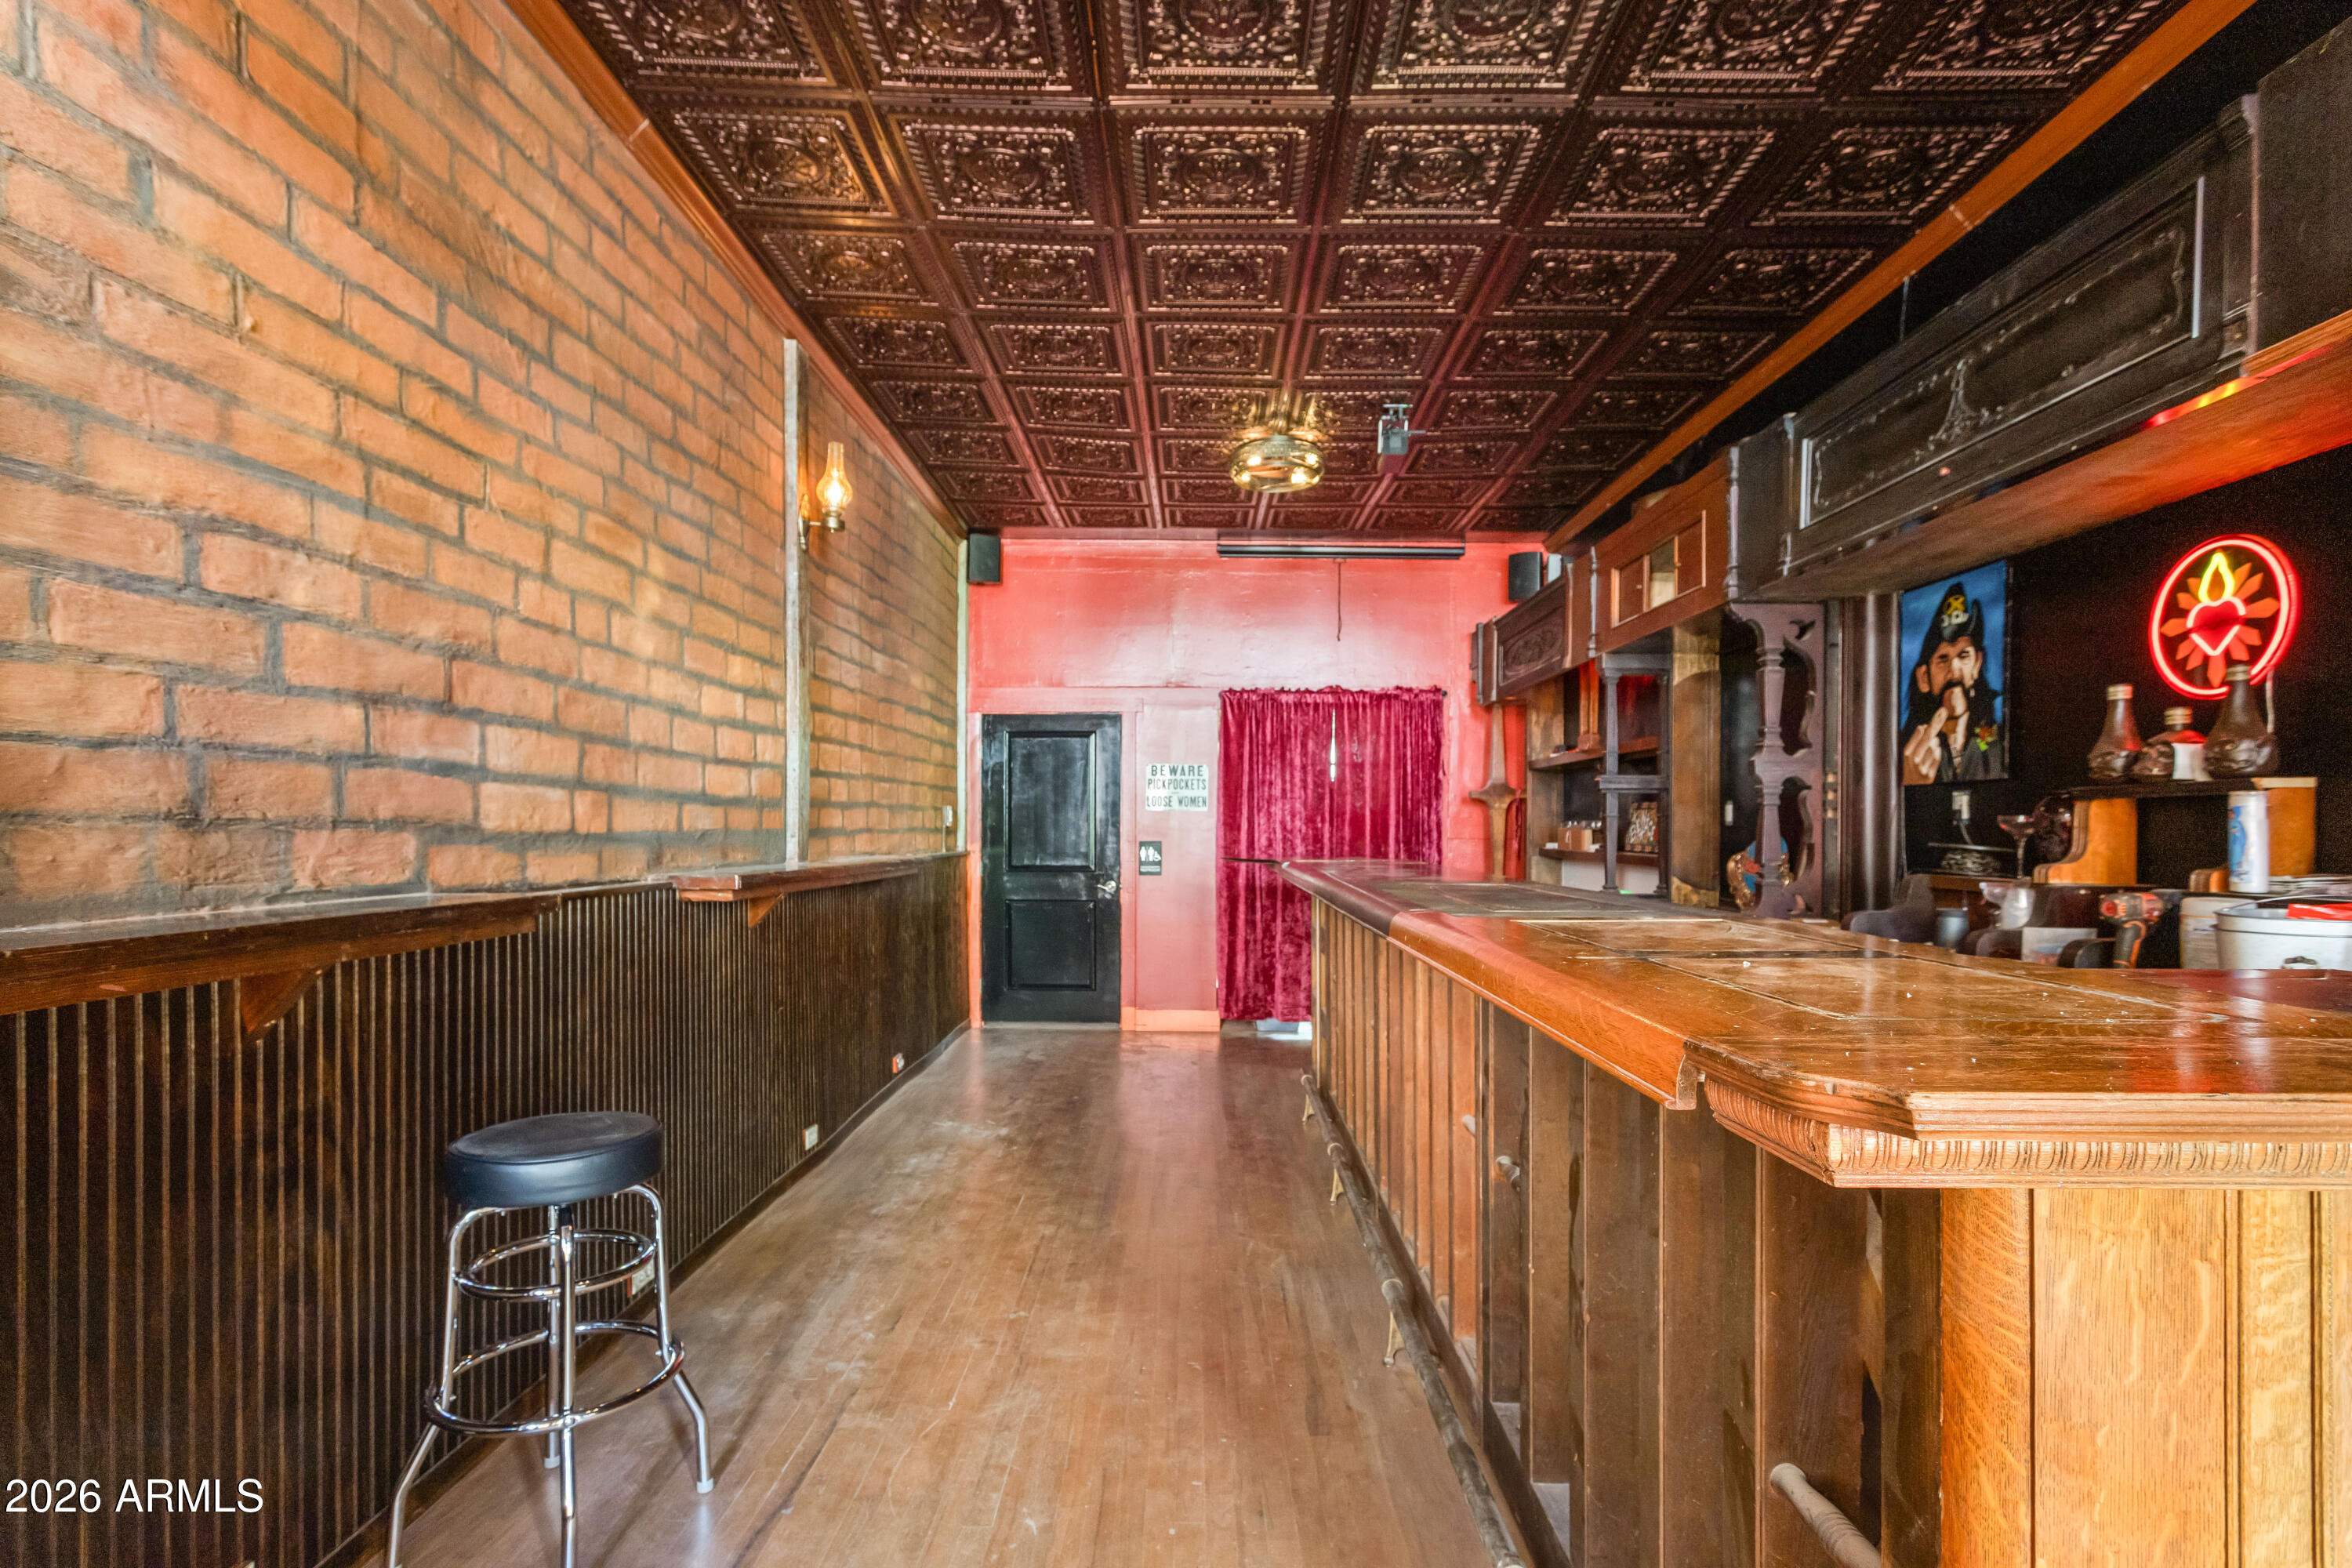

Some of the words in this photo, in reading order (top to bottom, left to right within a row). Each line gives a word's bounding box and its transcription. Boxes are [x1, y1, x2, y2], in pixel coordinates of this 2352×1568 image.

[1151, 765, 1203, 776] BEWARE
[1148, 779, 1207, 790] PICKPOCKETS
[1147, 796, 1173, 808] LOOSE
[1178, 796, 1207, 808] WOMEN
